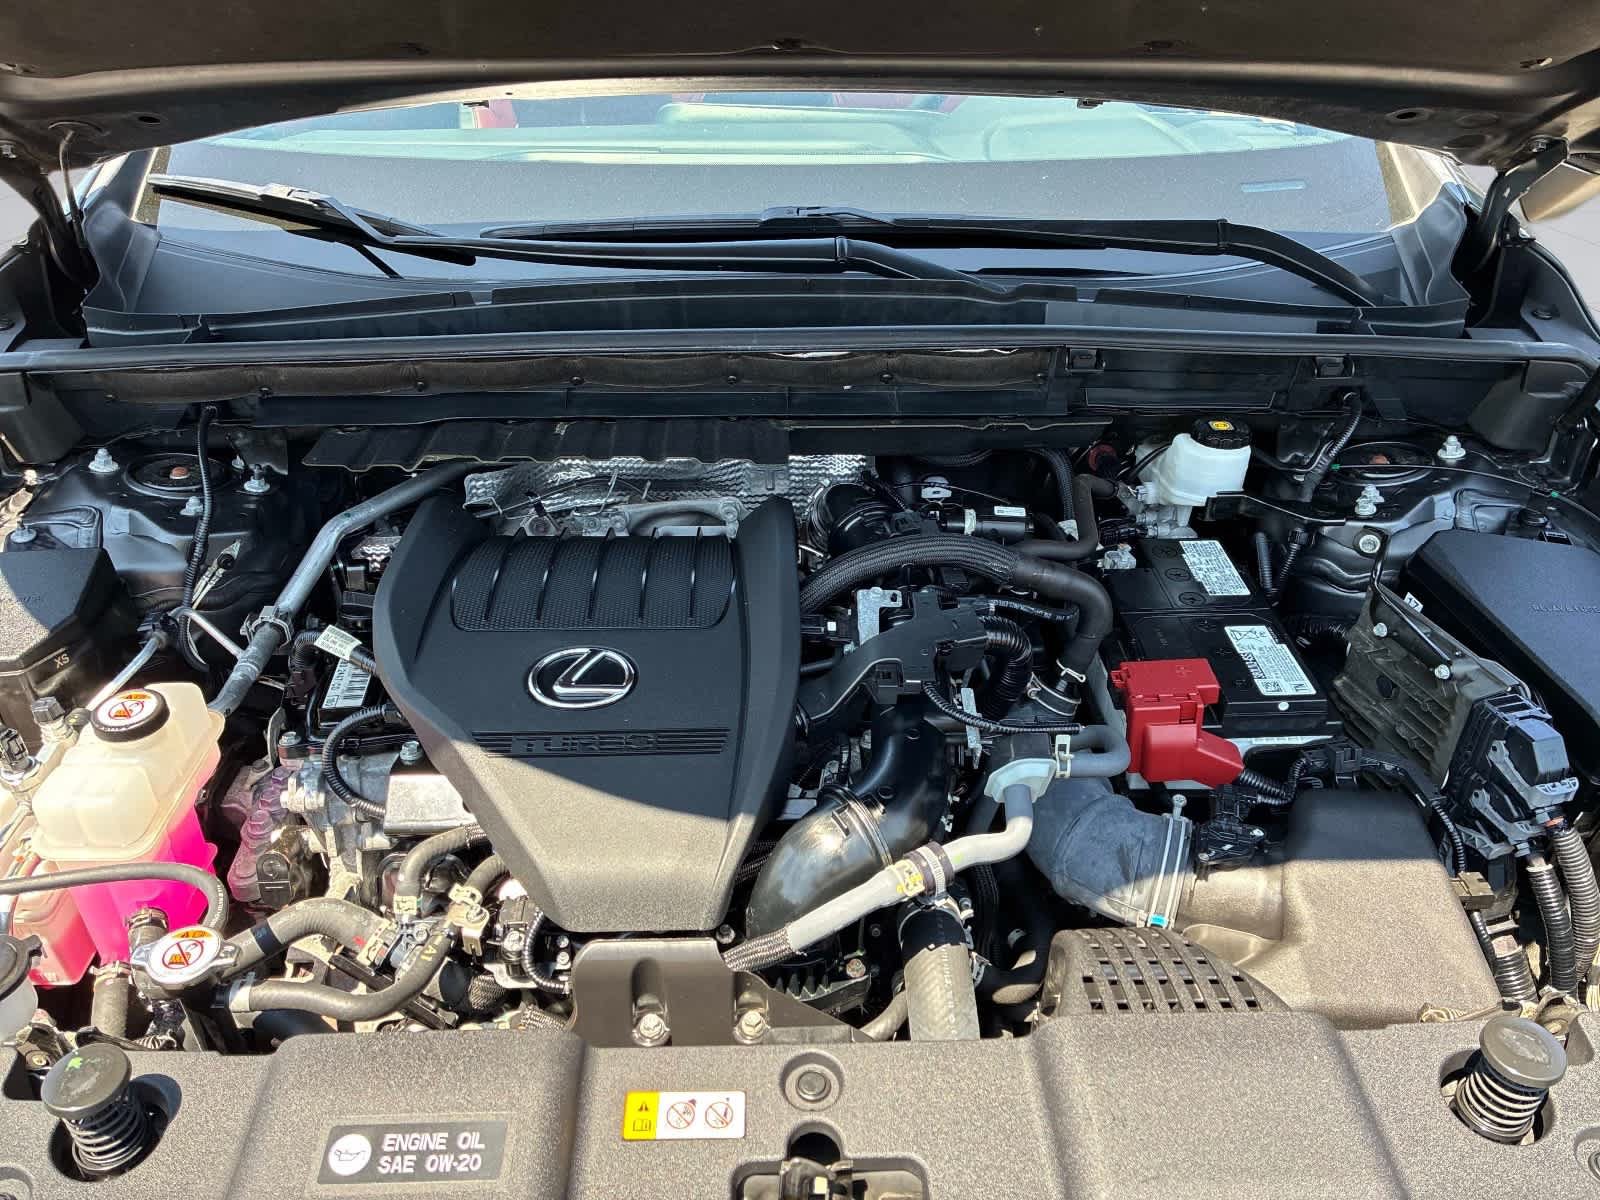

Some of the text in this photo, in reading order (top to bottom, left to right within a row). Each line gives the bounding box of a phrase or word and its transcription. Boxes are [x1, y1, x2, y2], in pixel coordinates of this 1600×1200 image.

[382, 1132, 486, 1152] ENGINE OIL
[377, 1153, 482, 1174] SAE 0W-20
